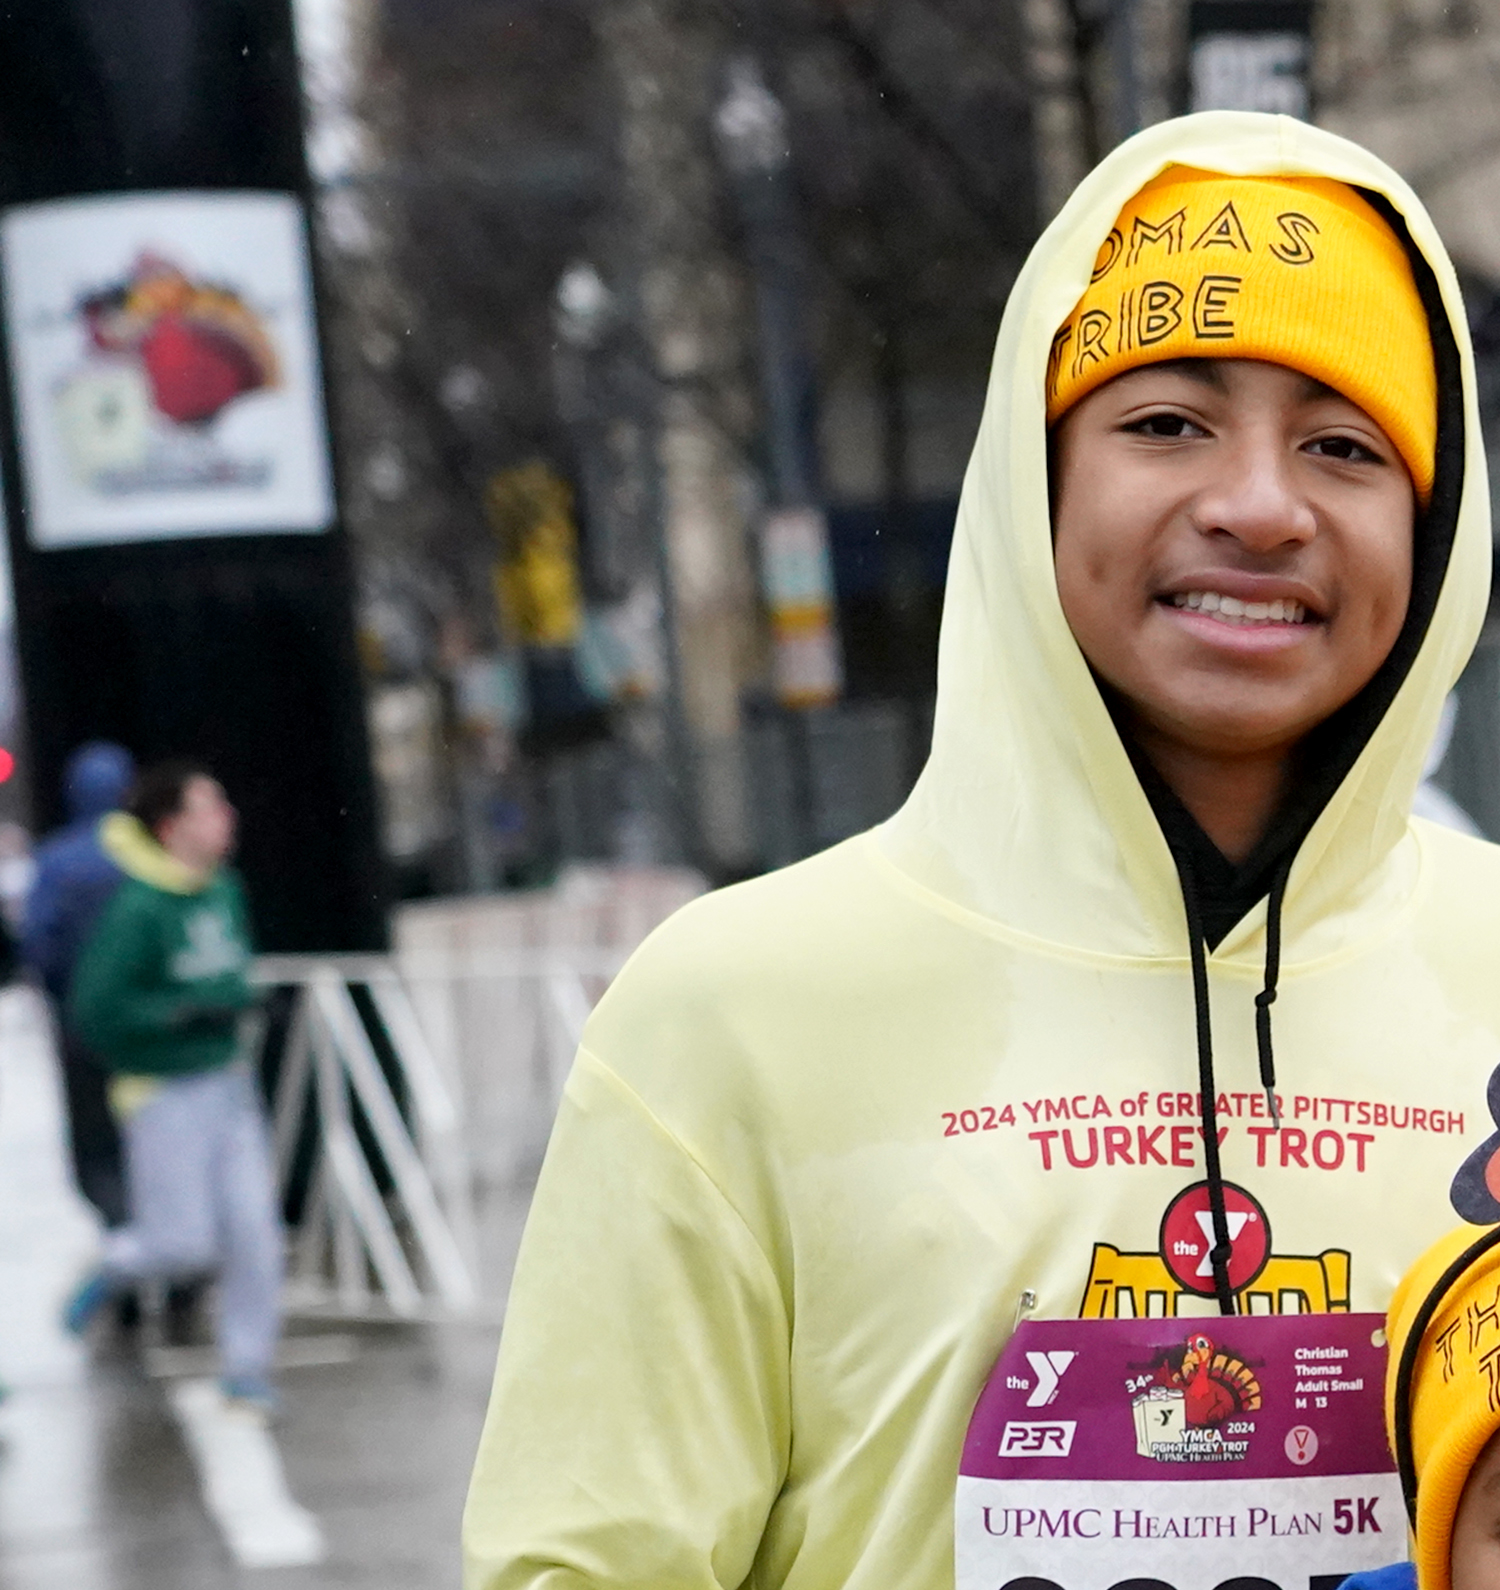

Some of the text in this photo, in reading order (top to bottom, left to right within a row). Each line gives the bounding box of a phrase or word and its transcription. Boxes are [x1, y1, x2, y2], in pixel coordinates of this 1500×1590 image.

[1091, 201, 1320, 285] OMAS
[942, 1103, 1016, 1137] 2024
[1023, 1096, 1110, 1124] YMCA
[1120, 1091, 1149, 1116] of
[1294, 1096, 1465, 1135] PITTSBURGH
[1247, 1126, 1375, 1173] TROT
[1173, 1240, 1199, 1256] the
[1294, 1346, 1348, 1360] Christian
[1294, 1364, 1342, 1376] Thomas
[1006, 1376, 1029, 1389] the
[1294, 1378, 1363, 1393] Adult Small
[1295, 1396, 1328, 1409] M 13
[1227, 1422, 1255, 1434] 2024
[1180, 1429, 1222, 1442] YMCA
[1221, 1441, 1249, 1452] TROT
[982, 1507, 1101, 1538] UPMC
[1333, 1496, 1382, 1536] 5K
